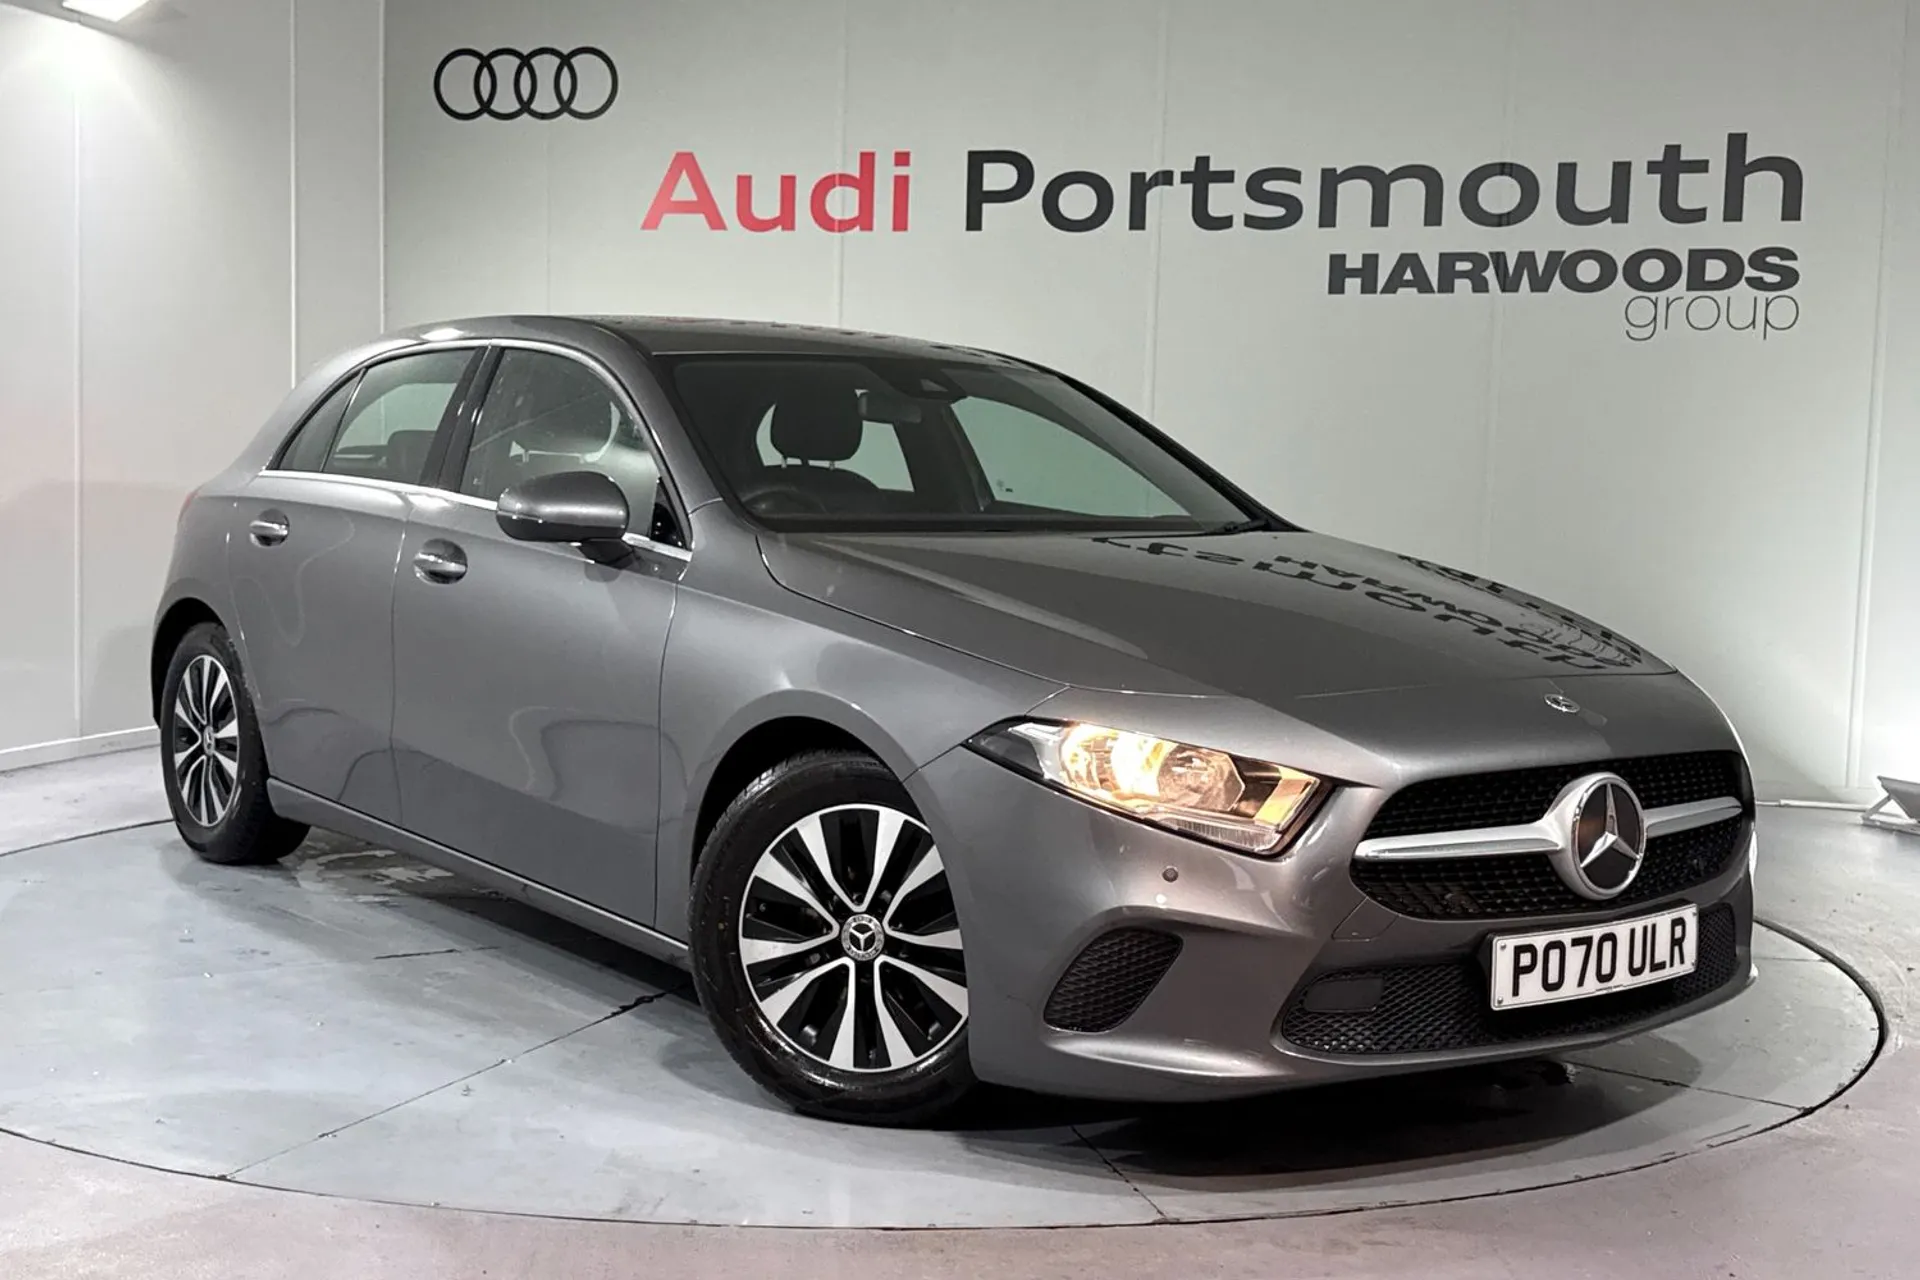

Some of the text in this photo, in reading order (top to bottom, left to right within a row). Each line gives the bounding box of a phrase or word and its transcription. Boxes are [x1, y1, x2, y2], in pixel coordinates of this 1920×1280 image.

[641, 132, 1804, 233] Audi Portsmouth
[1328, 247, 1800, 295] HARWOODS
[1624, 295, 1800, 342] group
[1512, 917, 1686, 997] PO70 ULR
